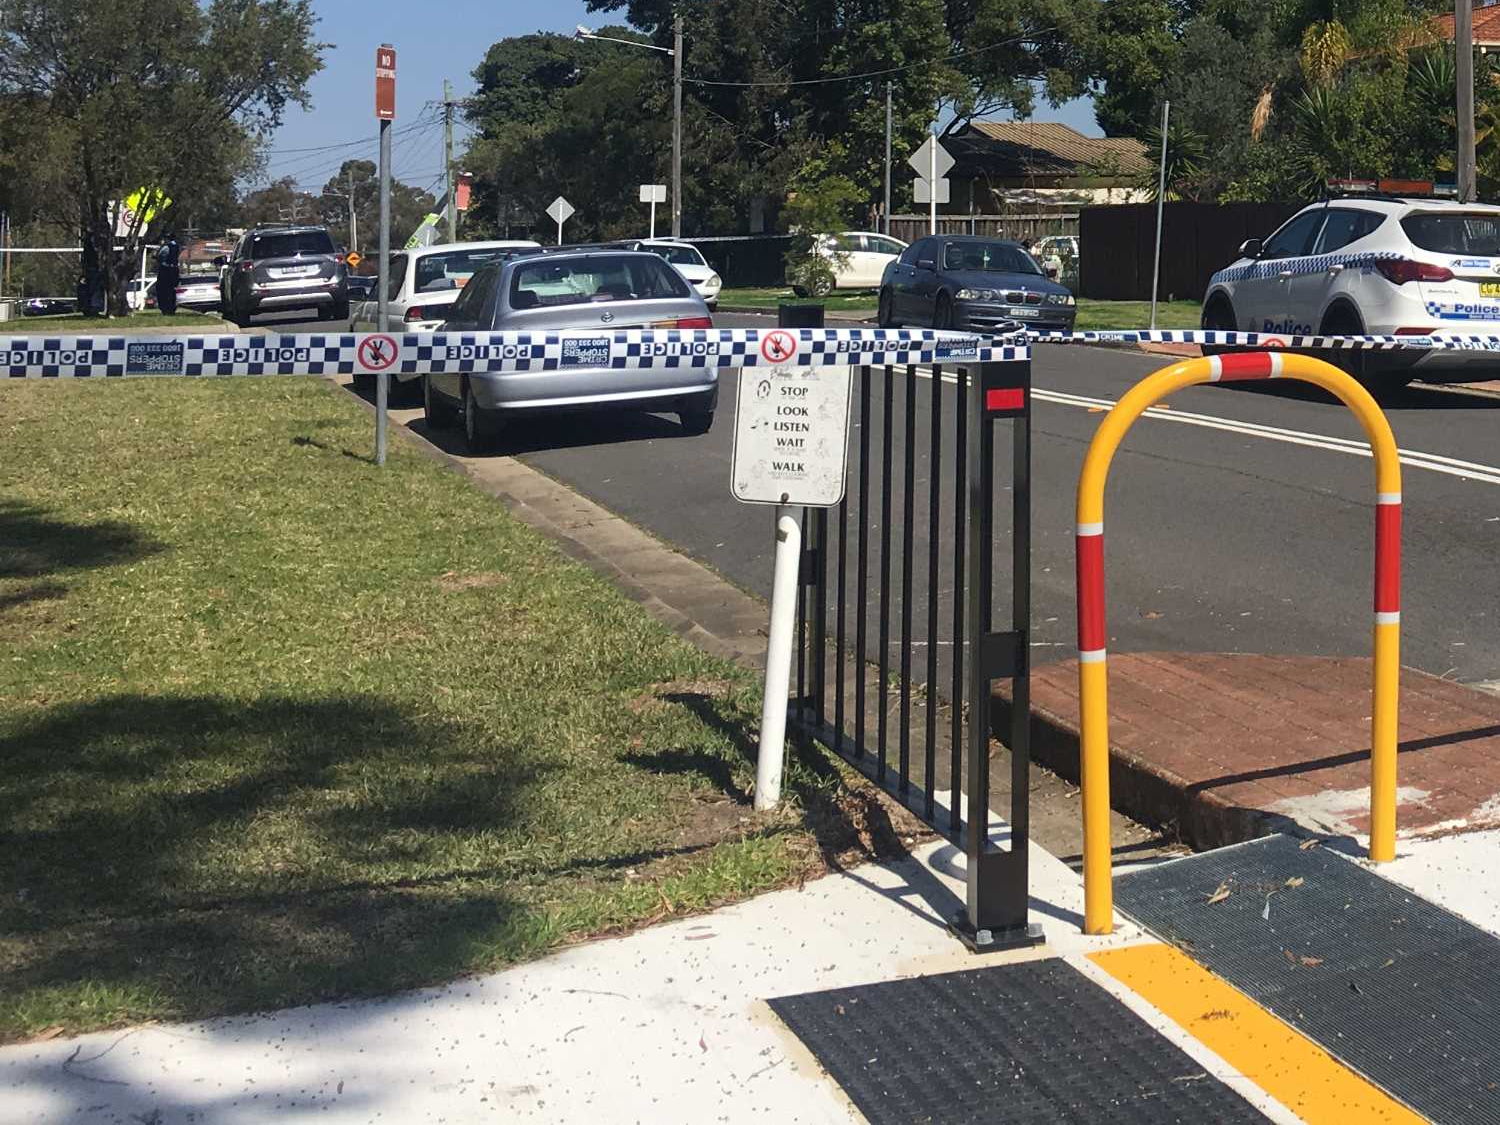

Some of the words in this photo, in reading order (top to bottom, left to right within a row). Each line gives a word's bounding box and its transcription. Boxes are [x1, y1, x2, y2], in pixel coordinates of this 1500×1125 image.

[382, 55, 391, 66] NO
[1454, 303, 1500, 314] Police
[1264, 319, 1312, 335] Police
[644, 342, 719, 355] POLICE
[839, 340, 910, 352] POLICE
[221, 348, 308, 362] POLICE
[449, 345, 528, 359] POLICE
[563, 347, 609, 357] STOPPERS
[129, 354, 181, 364] STOPPERS
[780, 386, 809, 396] STOP
[777, 406, 809, 416] LOOK
[773, 421, 810, 432] LISTEN
[776, 437, 805, 447] WAIT
[772, 461, 805, 472] WALK
